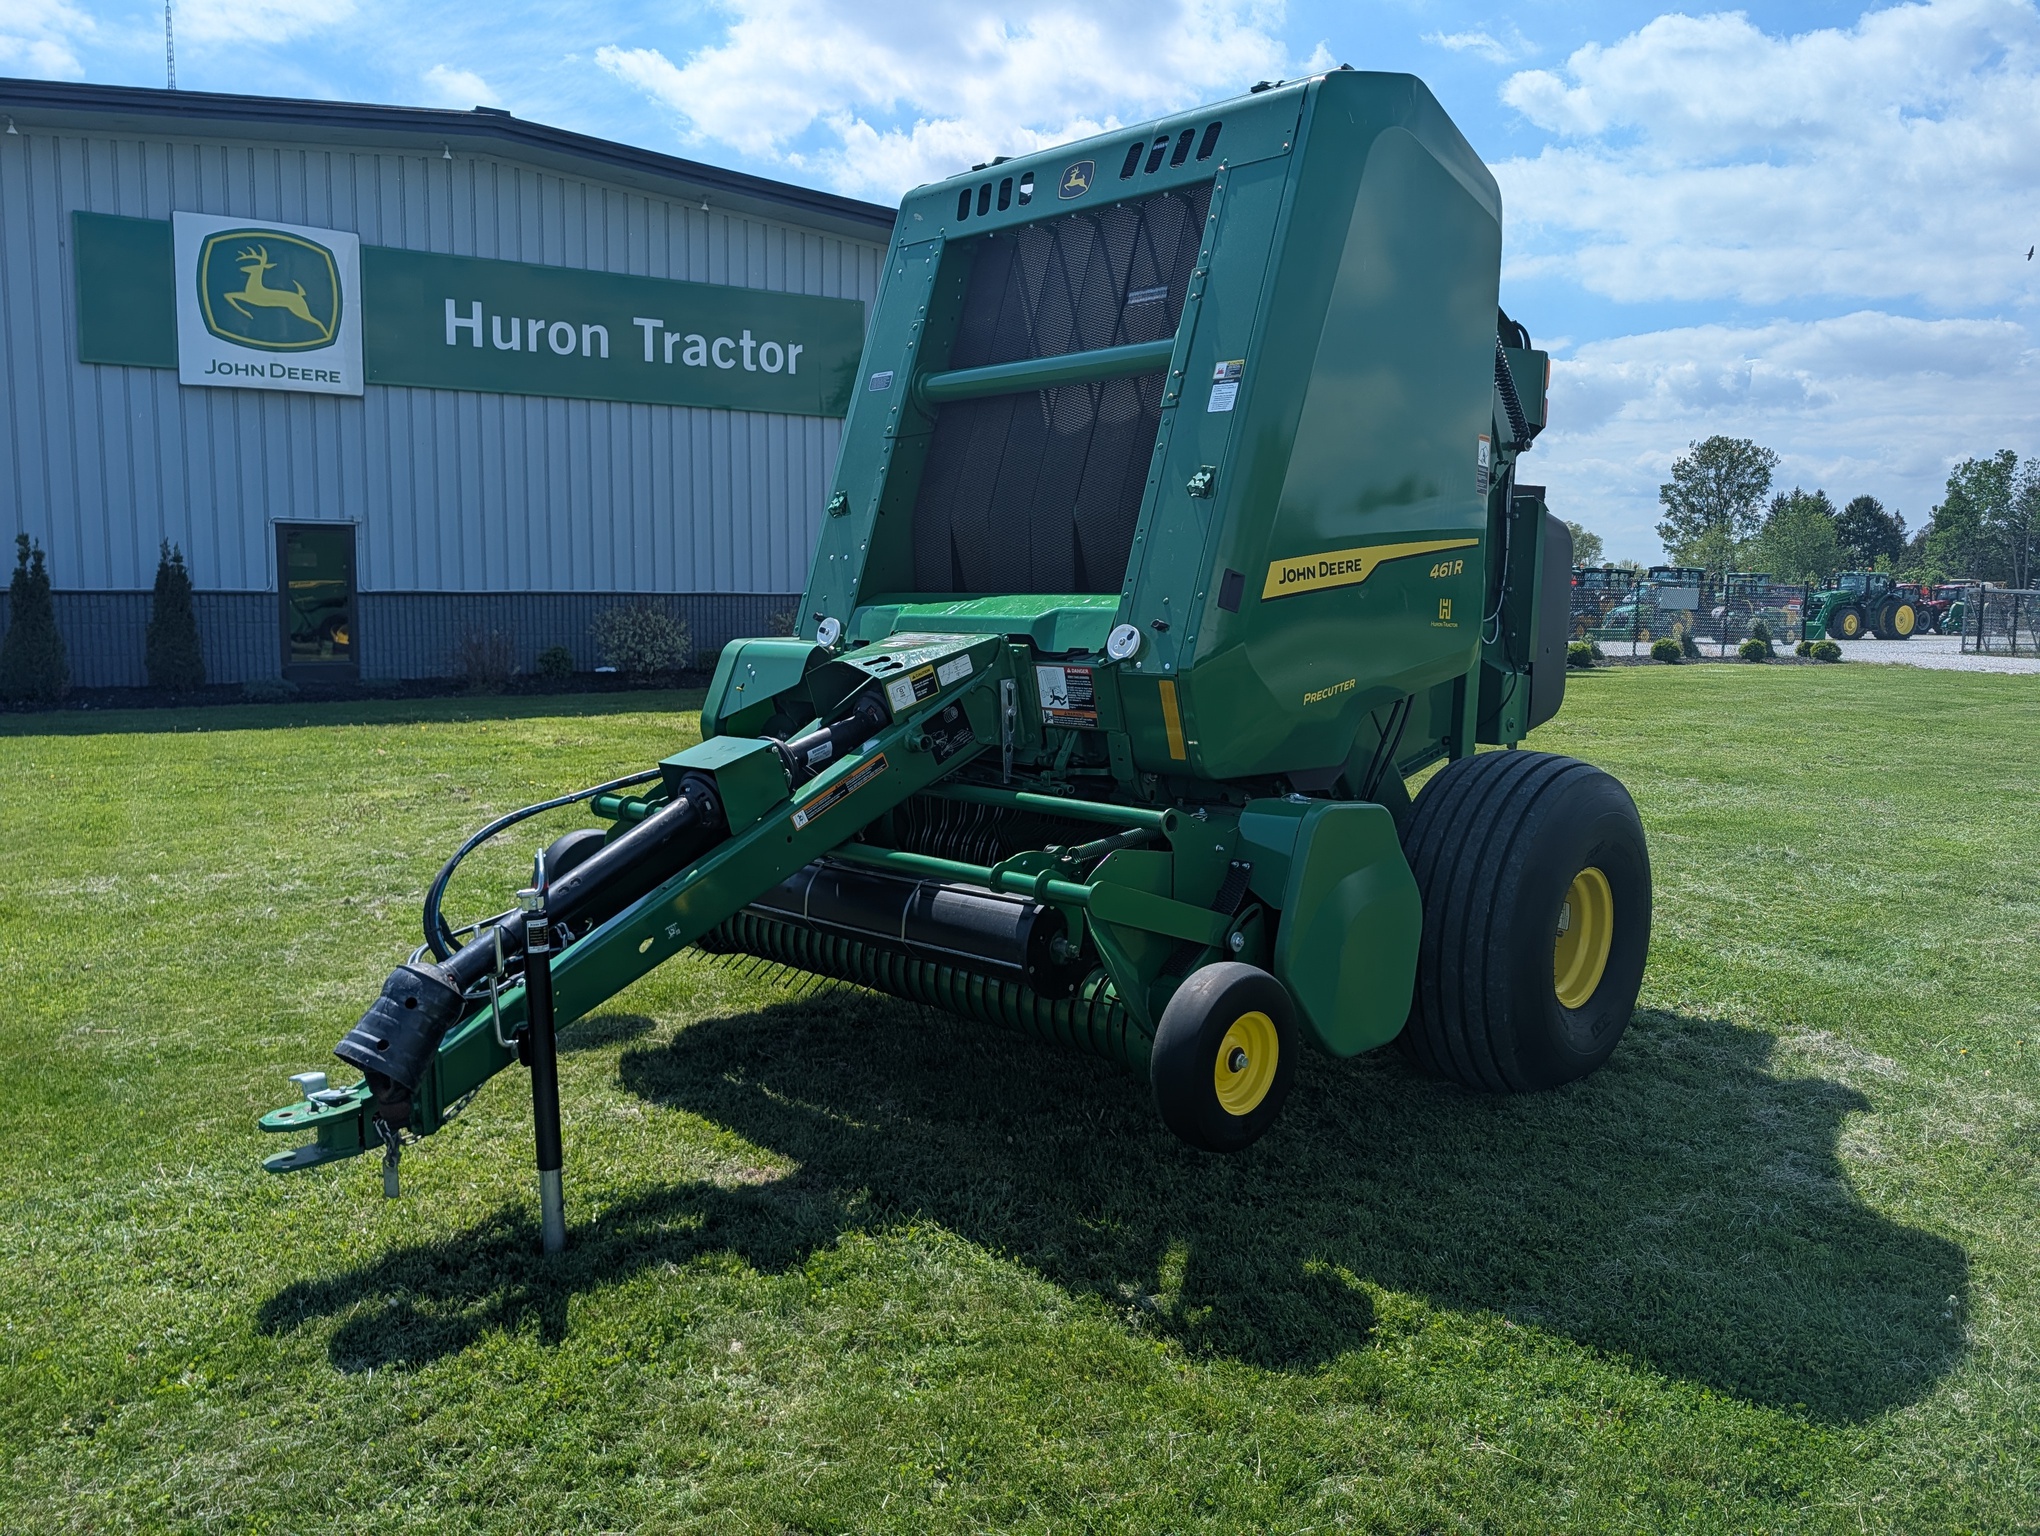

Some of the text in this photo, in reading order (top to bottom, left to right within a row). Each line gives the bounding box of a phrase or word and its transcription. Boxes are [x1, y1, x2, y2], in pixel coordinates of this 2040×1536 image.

[444, 298, 804, 375] Huron Tractor
[204, 359, 341, 384] JOHN DEERE
[1278, 558, 1362, 585] JOHN DEERE
[1429, 559, 1464, 579] 461R
[1303, 678, 1356, 706] PRECUTTER
